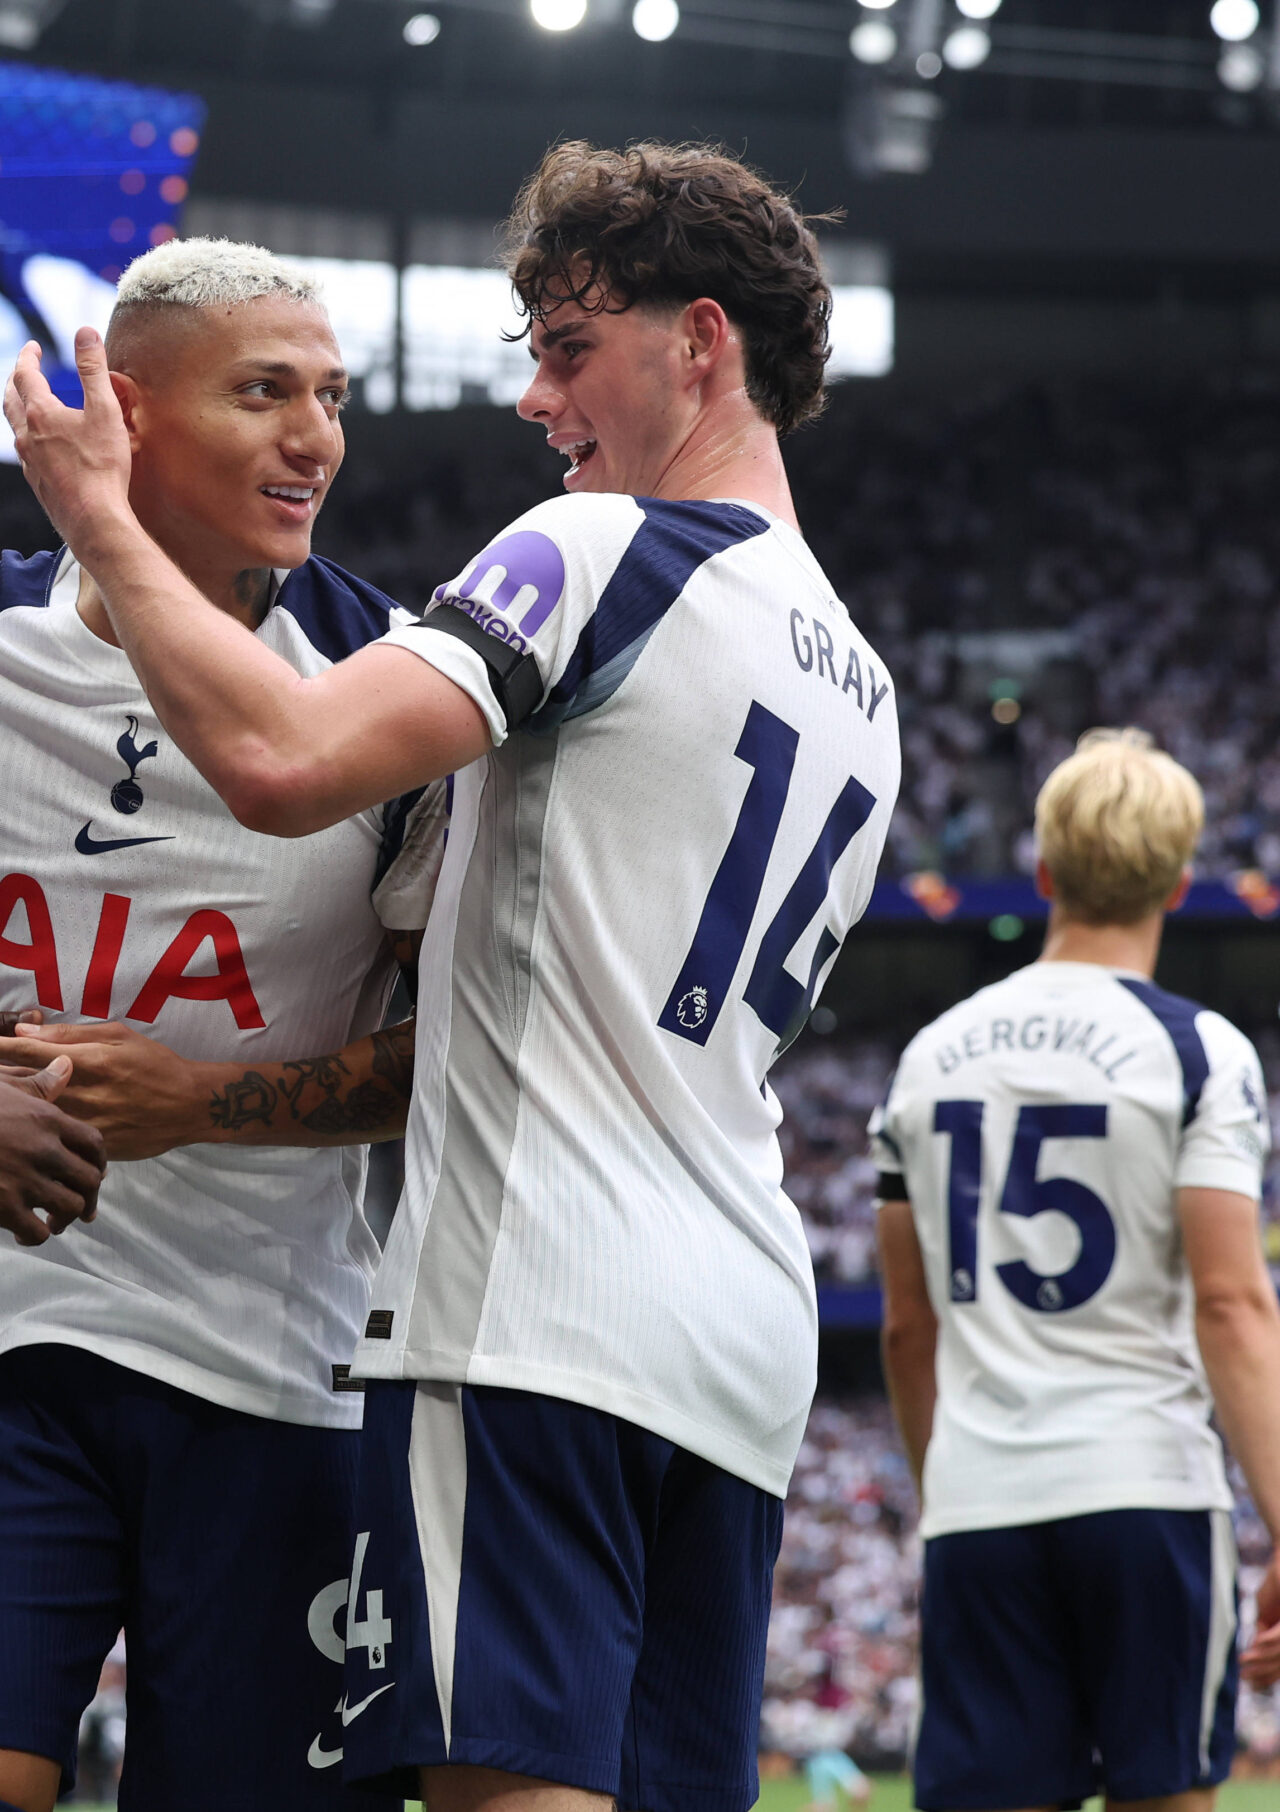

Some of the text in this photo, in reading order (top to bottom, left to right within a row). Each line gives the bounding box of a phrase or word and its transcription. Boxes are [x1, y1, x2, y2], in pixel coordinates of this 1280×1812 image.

[440, 596, 527, 653] raken
[790, 608, 888, 723] GRAY
[657, 700, 877, 1058] 14
[935, 1014, 1138, 1082] BERGVALL
[934, 1100, 1118, 1312] 15
